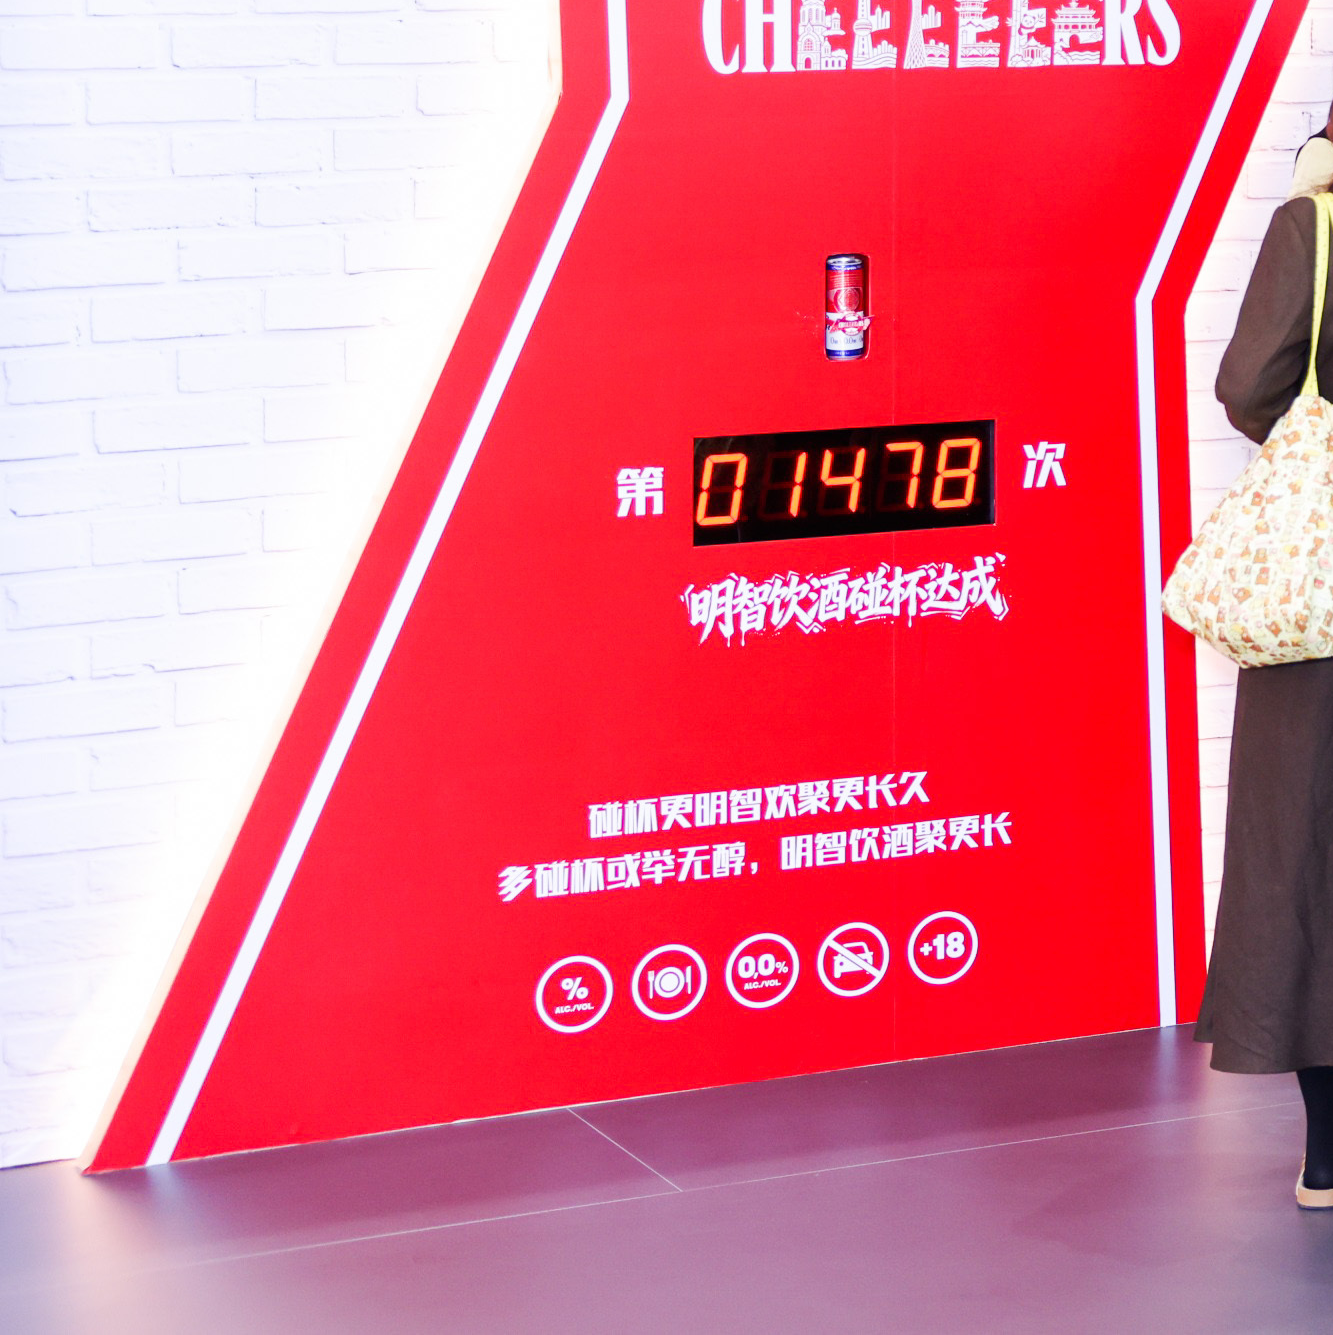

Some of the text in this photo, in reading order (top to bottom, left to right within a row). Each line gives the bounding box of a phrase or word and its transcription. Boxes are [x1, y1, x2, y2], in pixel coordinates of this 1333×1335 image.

[616, 438, 1067, 527] 第 01478 次
[679, 552, 1009, 647] 明智饮酒碰杯达成
[588, 770, 931, 839] 碰杯更明智欢聚更长久
[919, 930, 966, 961] +18
[561, 976, 589, 1001] %
[743, 979, 782, 991] ALC./VOL.
[554, 1003, 595, 1015] ALC./VOL.
